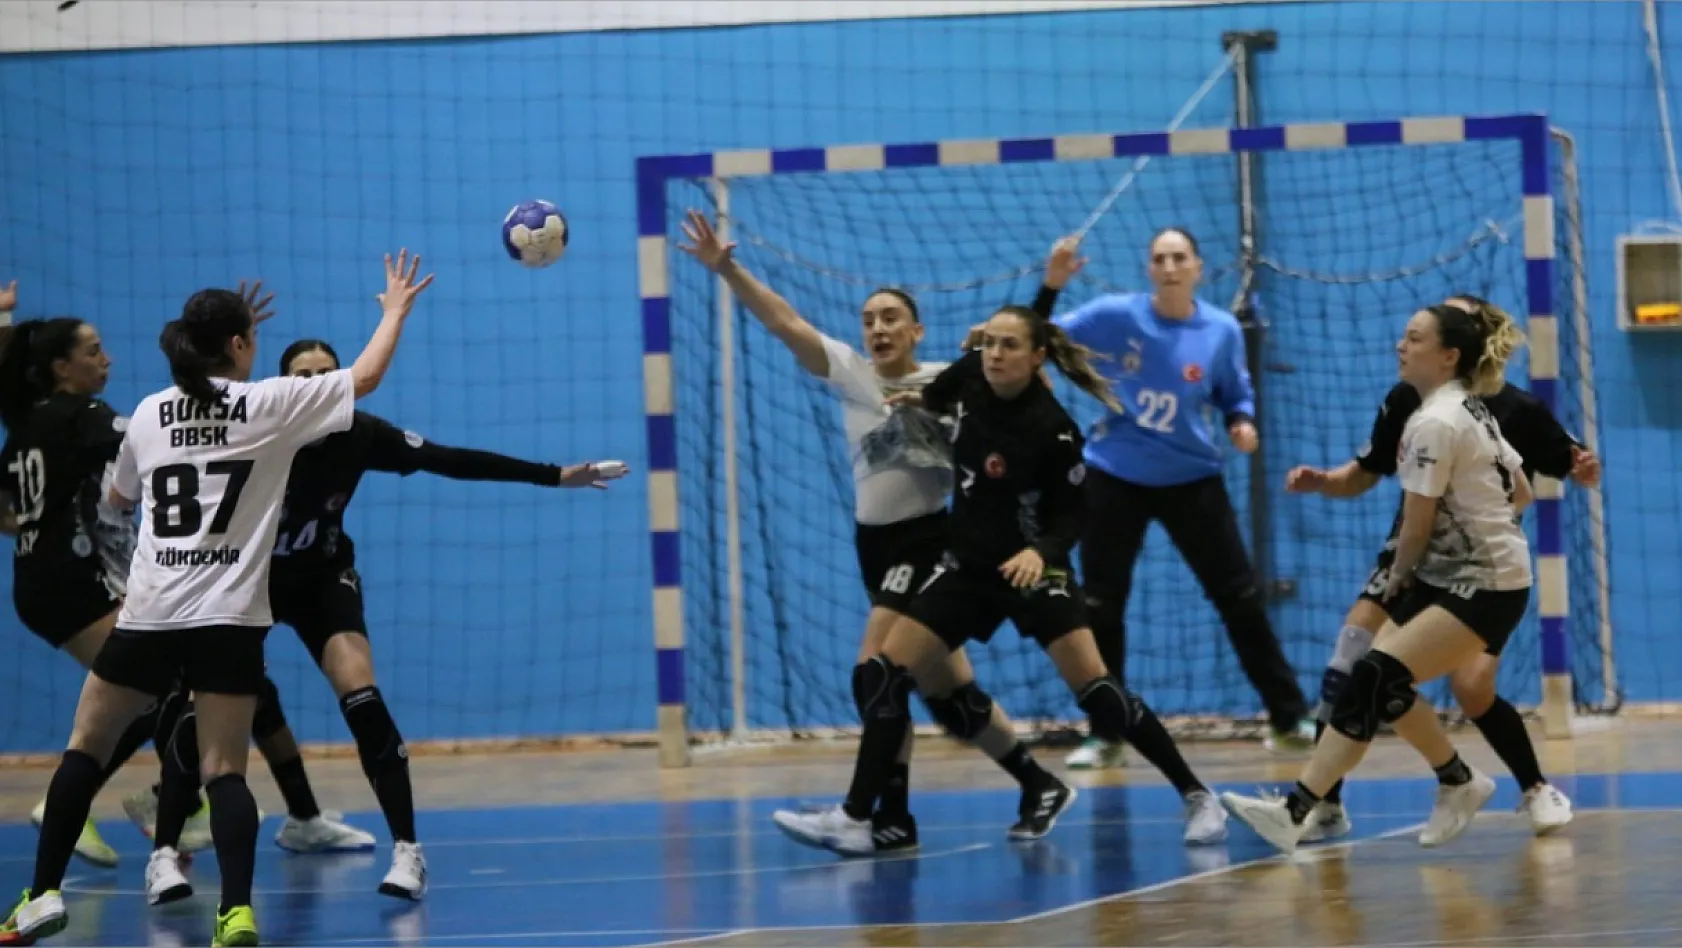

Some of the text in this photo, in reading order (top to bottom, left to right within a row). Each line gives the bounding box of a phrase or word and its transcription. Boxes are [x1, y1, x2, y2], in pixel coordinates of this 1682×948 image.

[1137, 388, 1178, 433] 22
[170, 426, 228, 448] BBSK
[152, 460, 255, 538] 87
